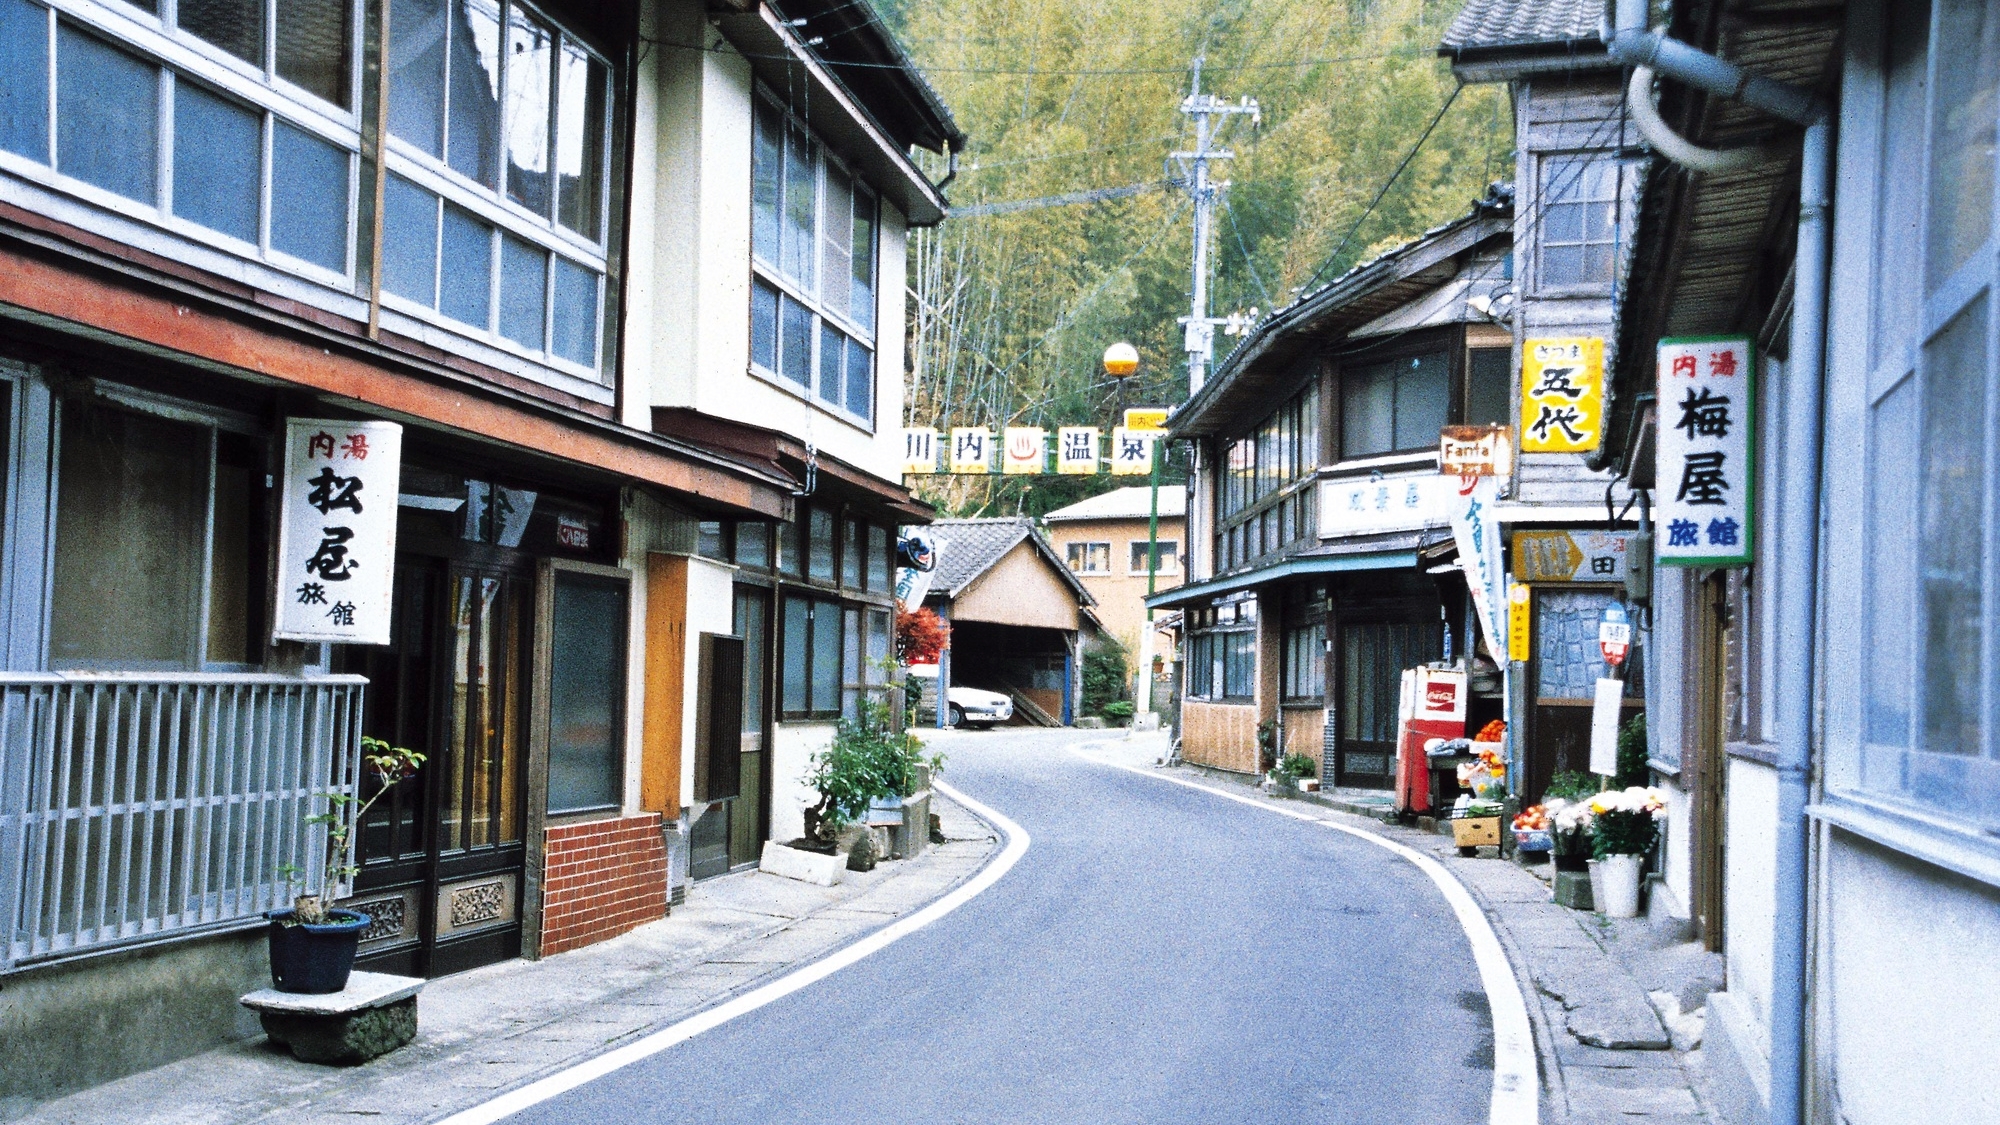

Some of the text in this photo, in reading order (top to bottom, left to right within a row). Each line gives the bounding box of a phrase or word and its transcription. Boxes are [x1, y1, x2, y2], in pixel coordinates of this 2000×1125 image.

[1536, 345, 1580, 359] さつま
[1532, 367, 1584, 441] 五代
[308, 430, 369, 460] 内湯
[1445, 442, 1490, 460] Fanta
[1675, 387, 1733, 506] 梅屋
[306, 467, 363, 581] 松屋
[1667, 516, 1740, 546] 旅館
[296, 582, 356, 626] 旅館
